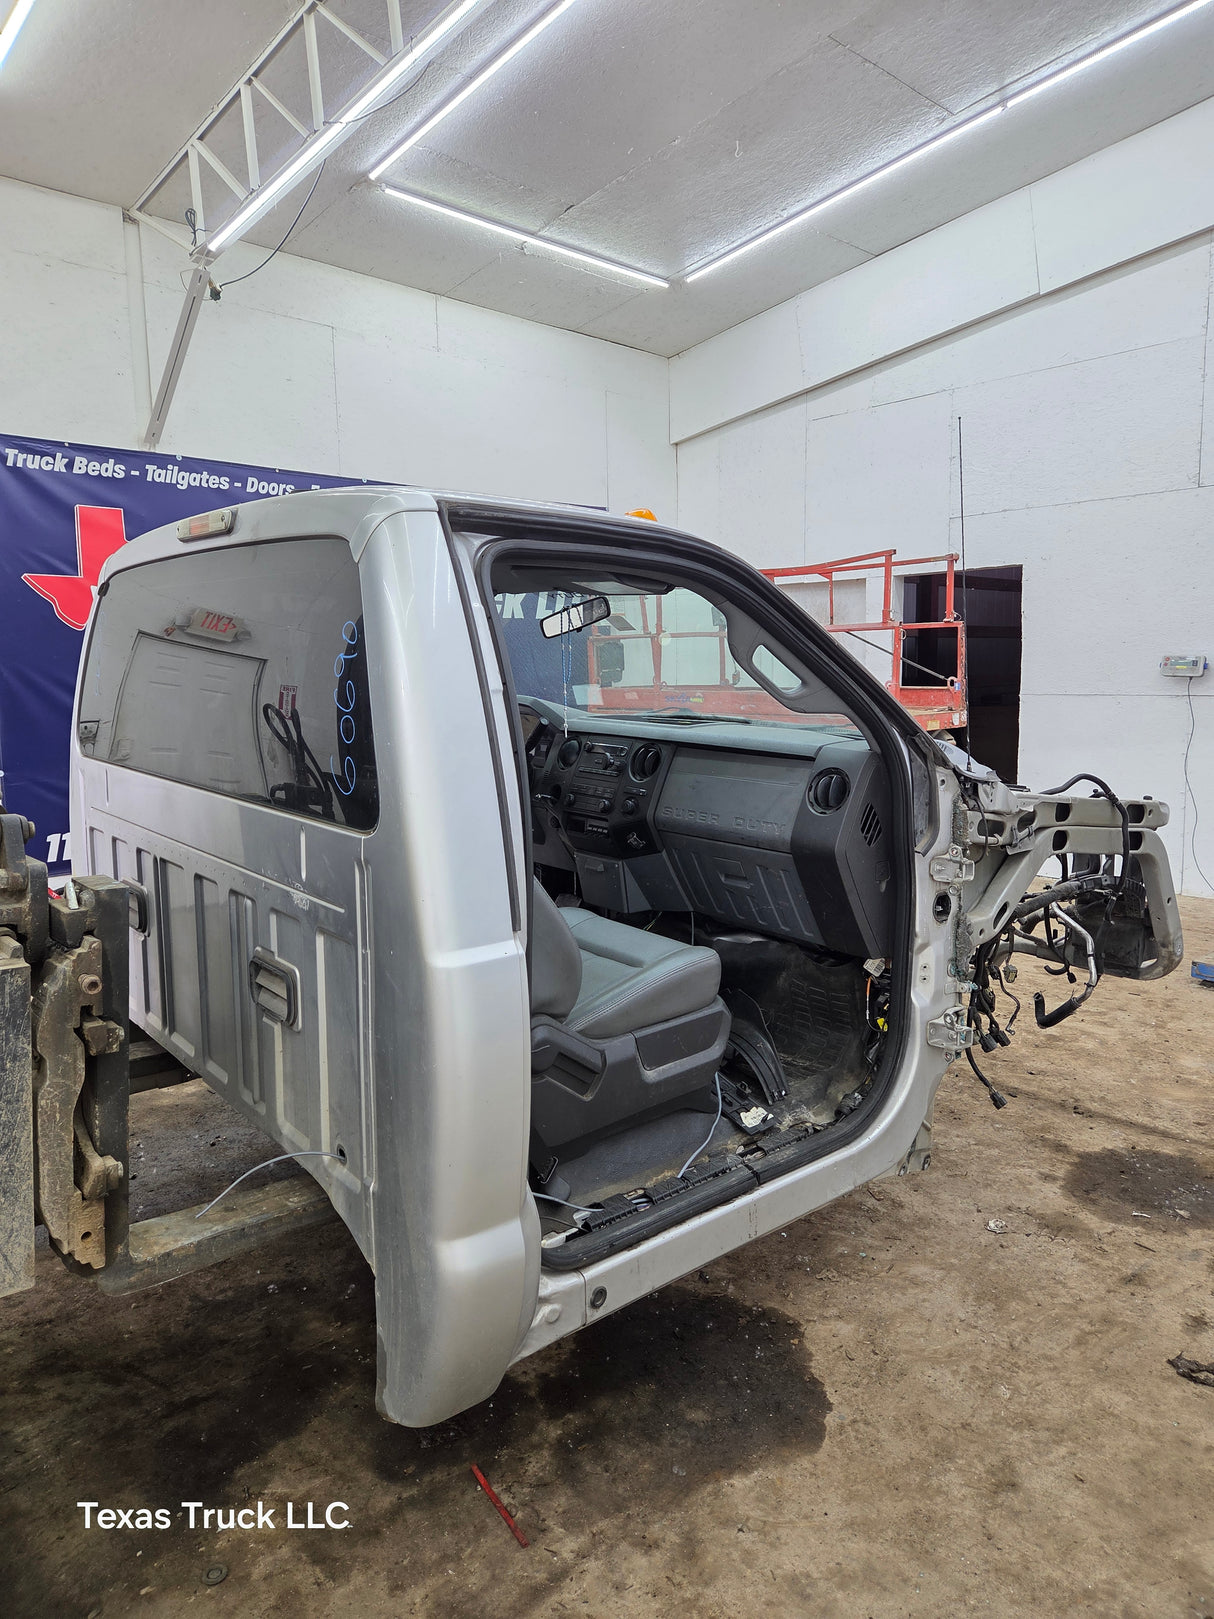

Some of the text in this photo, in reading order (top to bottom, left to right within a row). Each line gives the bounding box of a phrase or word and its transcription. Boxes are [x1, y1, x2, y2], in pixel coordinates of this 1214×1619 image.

[5, 449, 67, 473] Truck
[72, 456, 126, 479] Beds
[145, 464, 230, 490] Tailgates
[246, 476, 296, 496] Doors
[661, 806, 786, 836] SUPER DUTY
